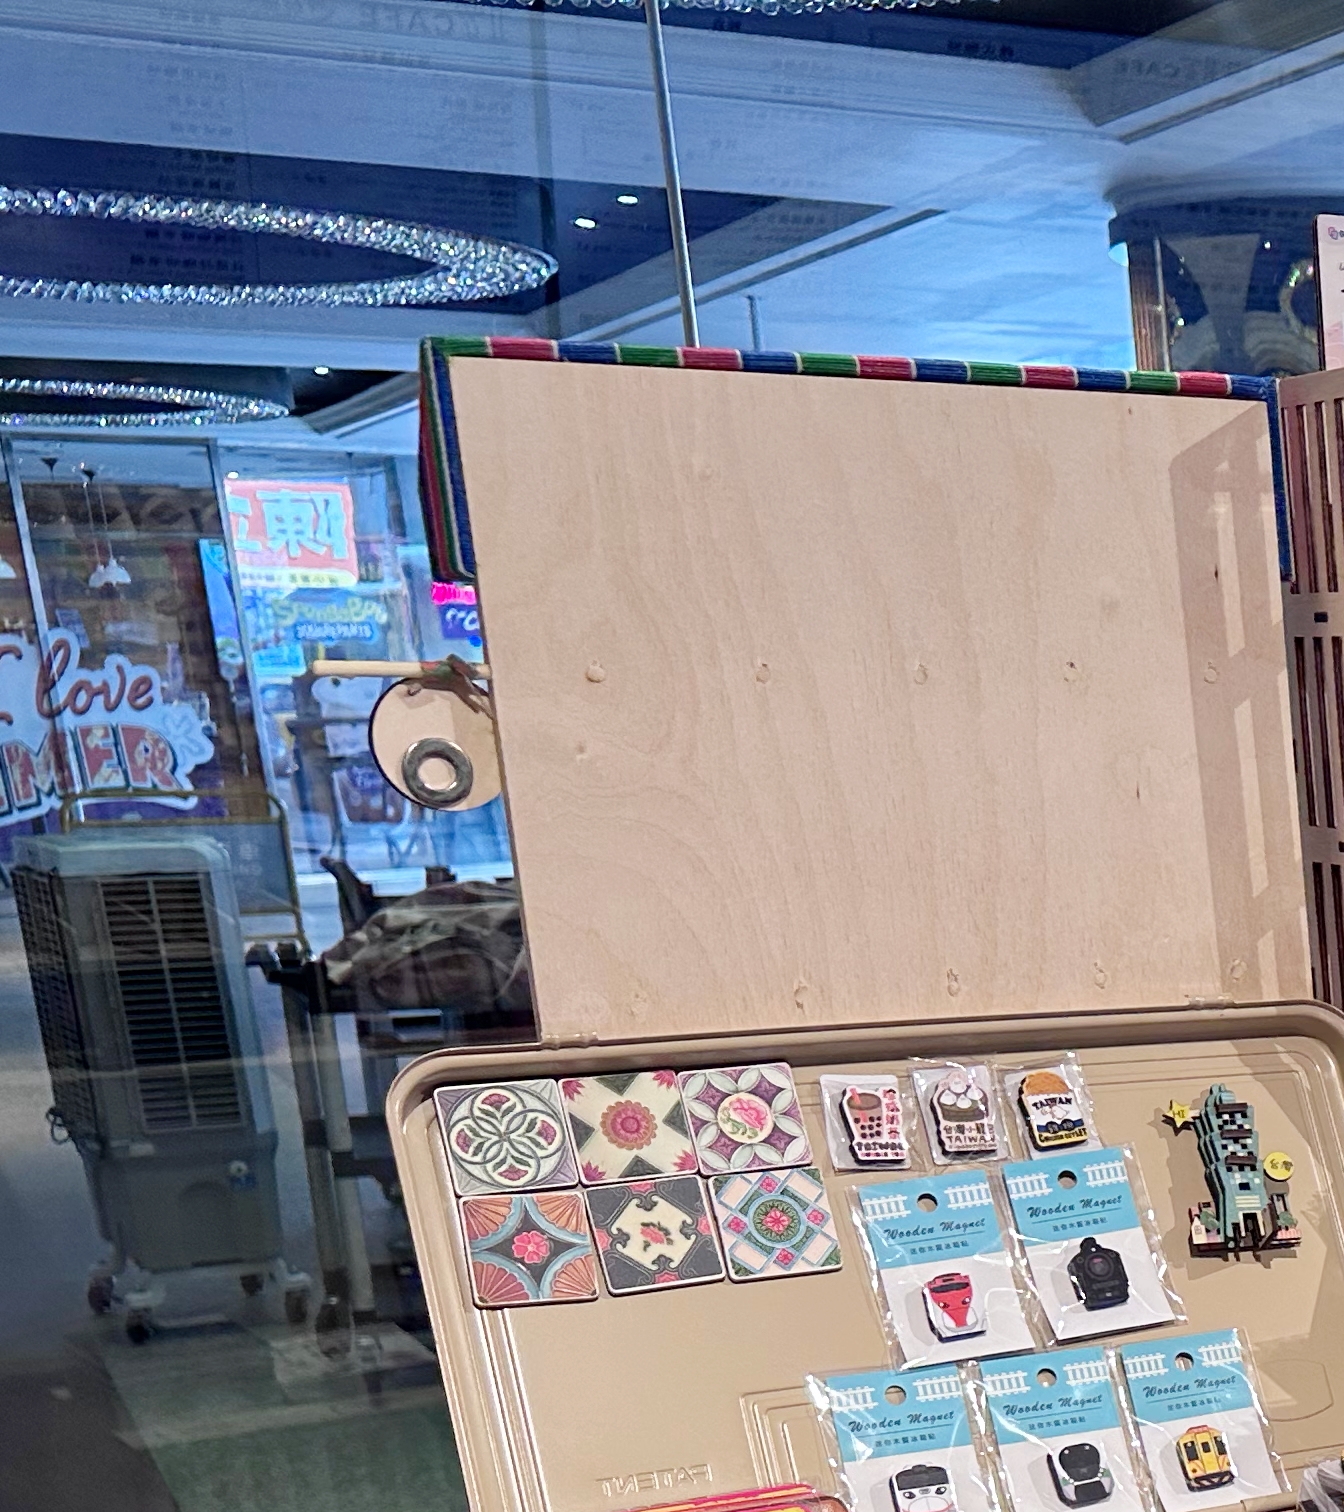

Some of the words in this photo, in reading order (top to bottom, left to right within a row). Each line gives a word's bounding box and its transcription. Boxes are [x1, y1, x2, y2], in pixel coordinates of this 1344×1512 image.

[35, 638, 154, 720] love
[1026, 1202, 1075, 1219] Wooden
[1080, 1195, 1123, 1213] Magnet
[883, 1225, 935, 1241] Wooden
[939, 1217, 986, 1235] Magnet
[1142, 1383, 1190, 1399] Wooden
[1193, 1373, 1238, 1393] Magnet
[1002, 1400, 1054, 1416] Wooden
[1058, 1393, 1103, 1411] Magnet
[847, 1416, 902, 1433] Wooden
[906, 1409, 955, 1428] Magnet
